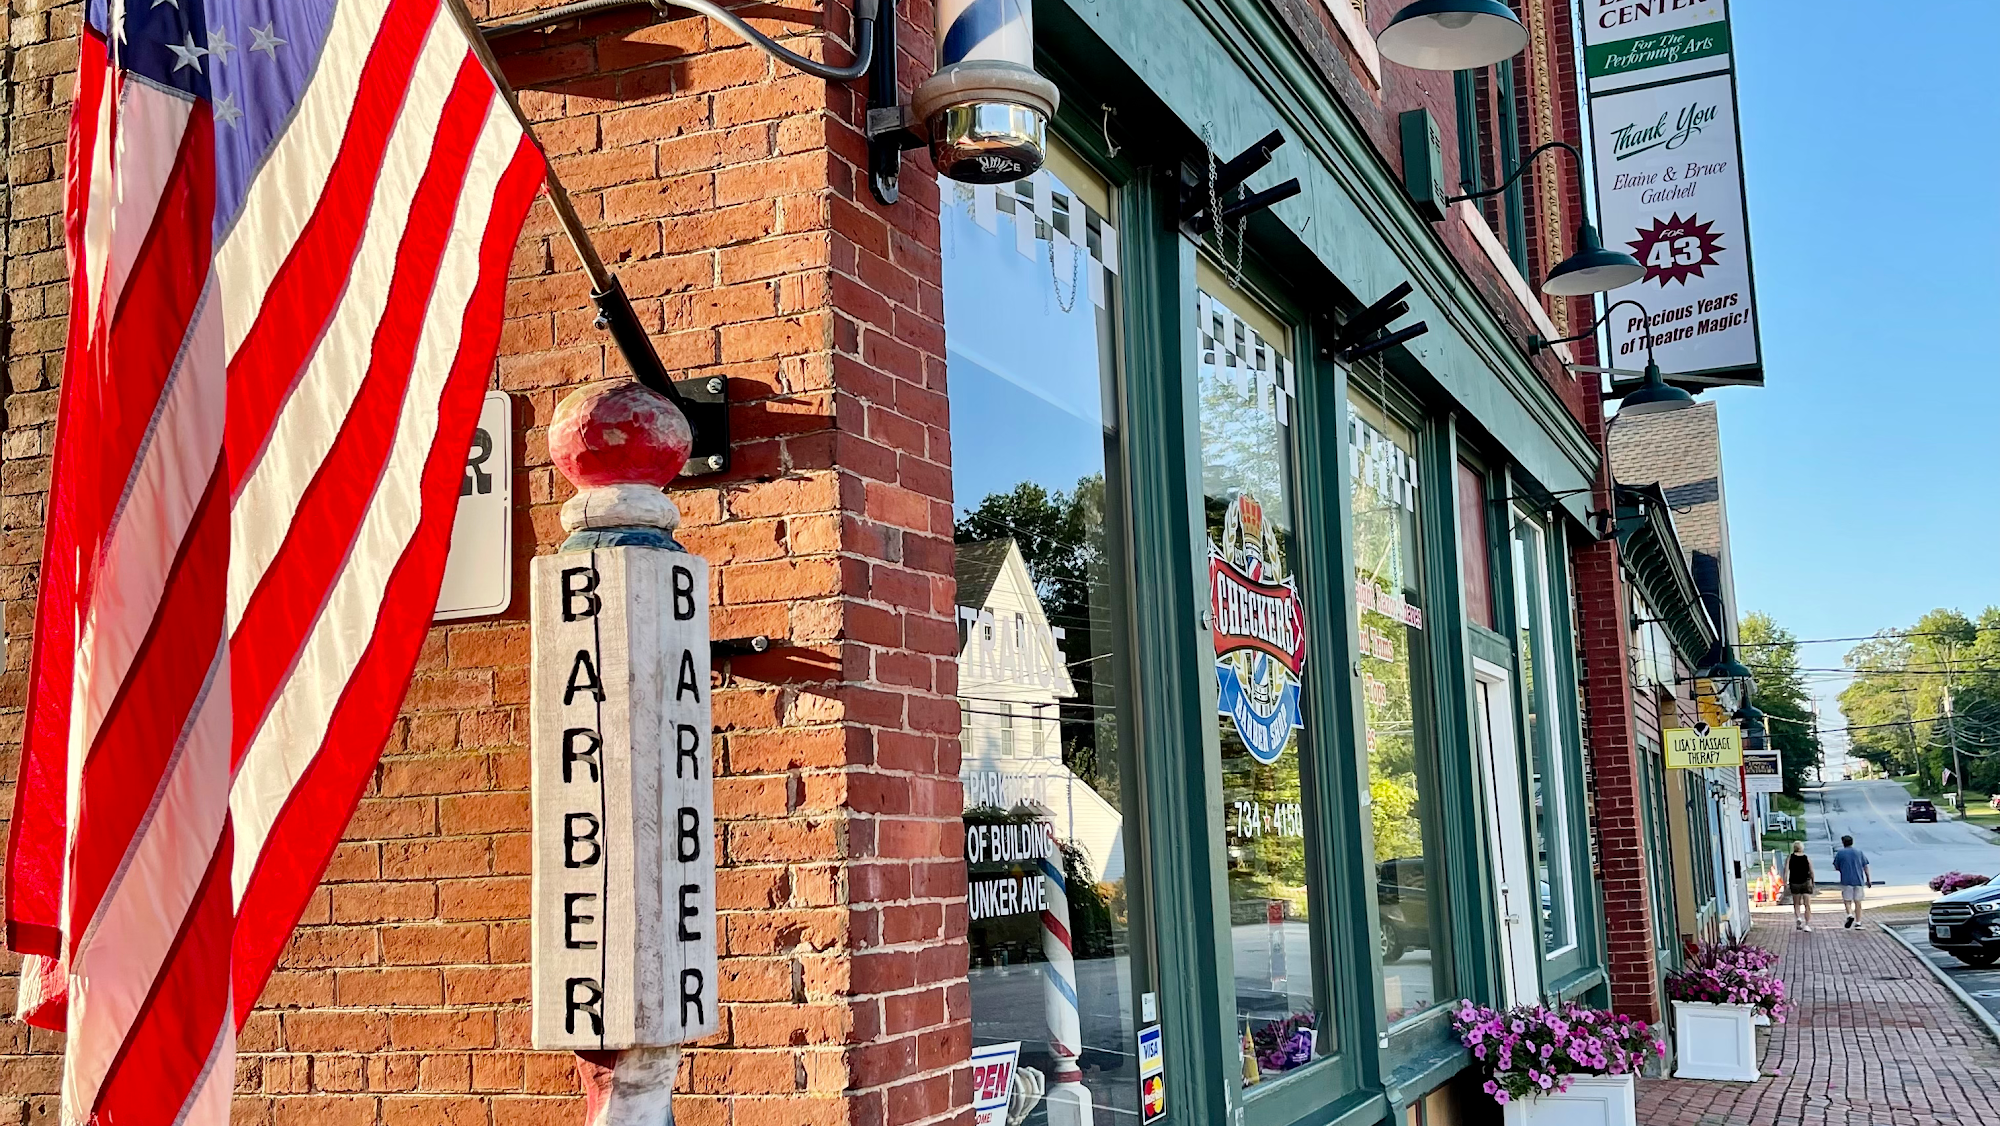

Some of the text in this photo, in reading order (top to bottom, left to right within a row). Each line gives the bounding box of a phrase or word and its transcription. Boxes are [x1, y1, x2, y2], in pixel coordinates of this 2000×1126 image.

[1604, 37, 1713, 69] Performing Arts
[1632, 34, 1685, 52] For The
[1610, 102, 1718, 154] Thank You
[1612, 162, 1727, 191] Elaine & Bruce
[1641, 182, 1697, 204] Gatchell
[1647, 236, 1703, 269] 43
[1659, 228, 1684, 239] FOR
[1620, 308, 1749, 355] of Theatre Magic!
[1627, 293, 1738, 333] Precious Years
[1217, 570, 1295, 657] CHECKERS
[955, 604, 1067, 691] TRANCE
[1235, 691, 1288, 752] BARBER SHOP
[1674, 737, 1731, 752] LISA'S MASSAGE
[1688, 752, 1720, 764] THERAPY
[561, 567, 606, 1036] BARBER
[671, 565, 704, 1026] BARBER
[1235, 801, 1261, 838] 734
[968, 822, 1054, 864] OF BUILDING
[1021, 875, 1050, 914] AVE.
[1143, 1041, 1158, 1060] VISA
